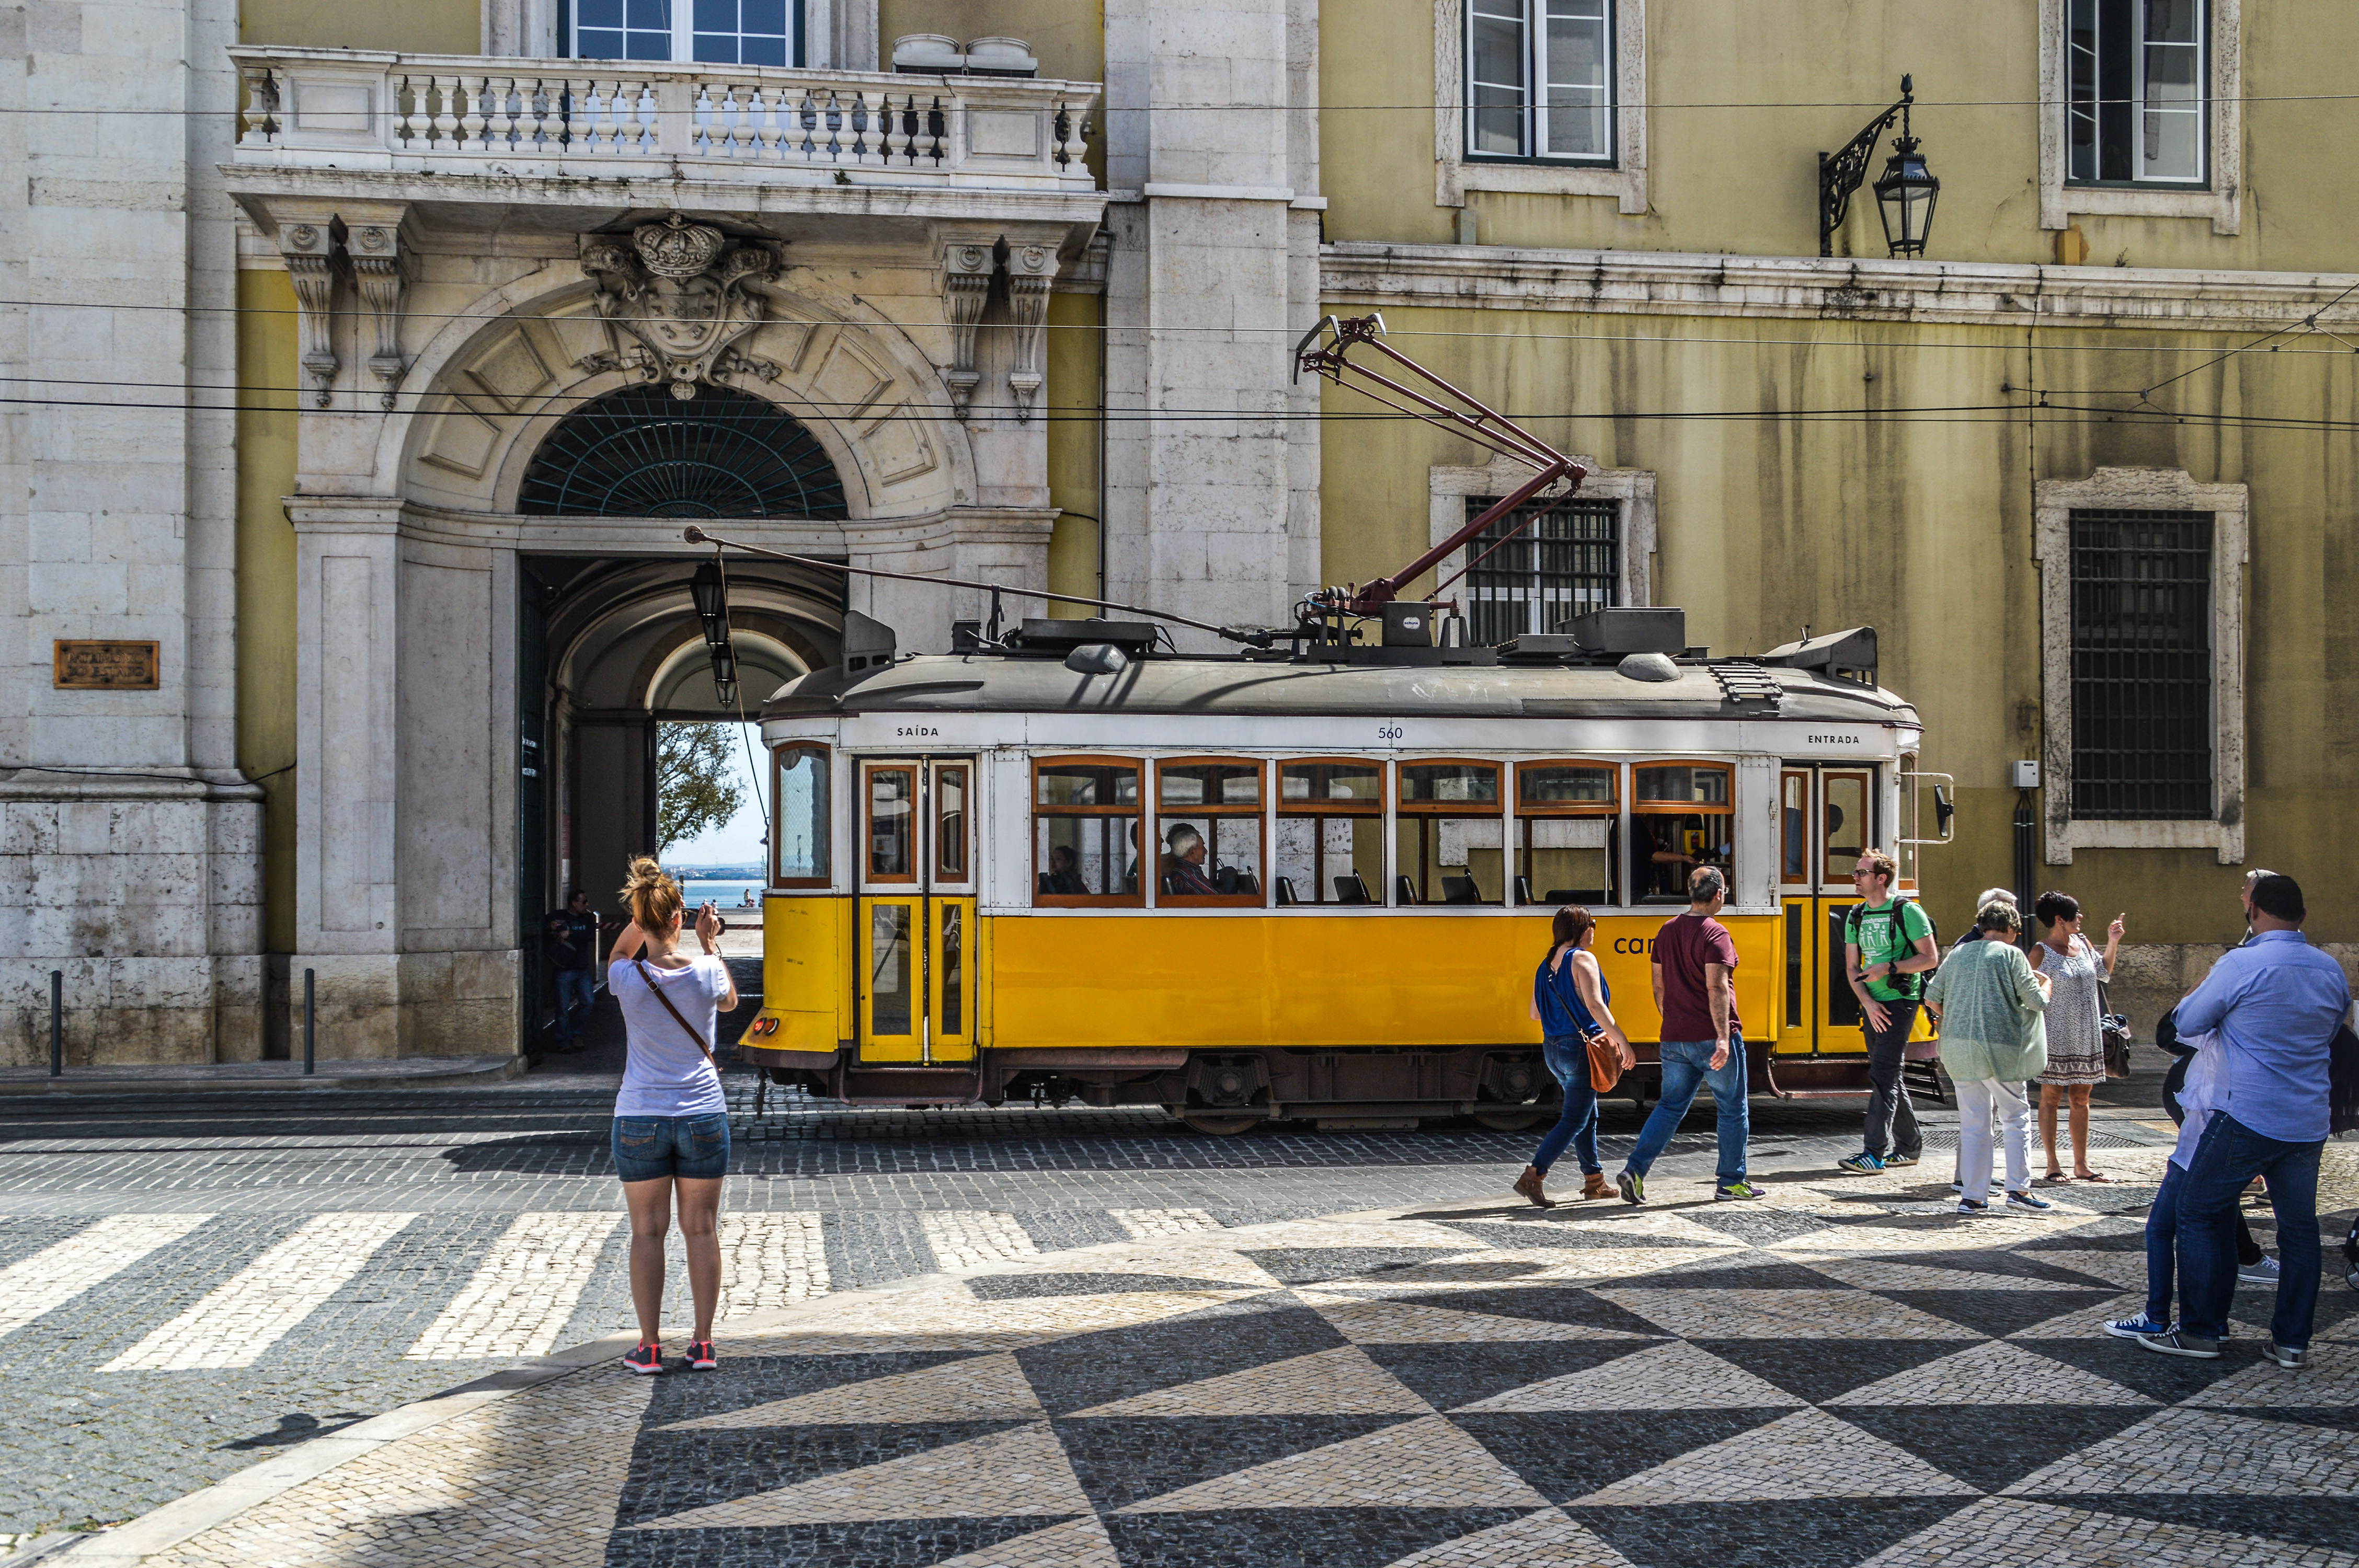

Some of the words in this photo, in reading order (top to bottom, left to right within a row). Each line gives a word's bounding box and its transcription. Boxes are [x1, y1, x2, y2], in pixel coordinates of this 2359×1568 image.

[897, 724, 938, 736] SAÍDA
[1378, 727, 1403, 739] 560
[1808, 735, 1859, 744] ENTRADA
